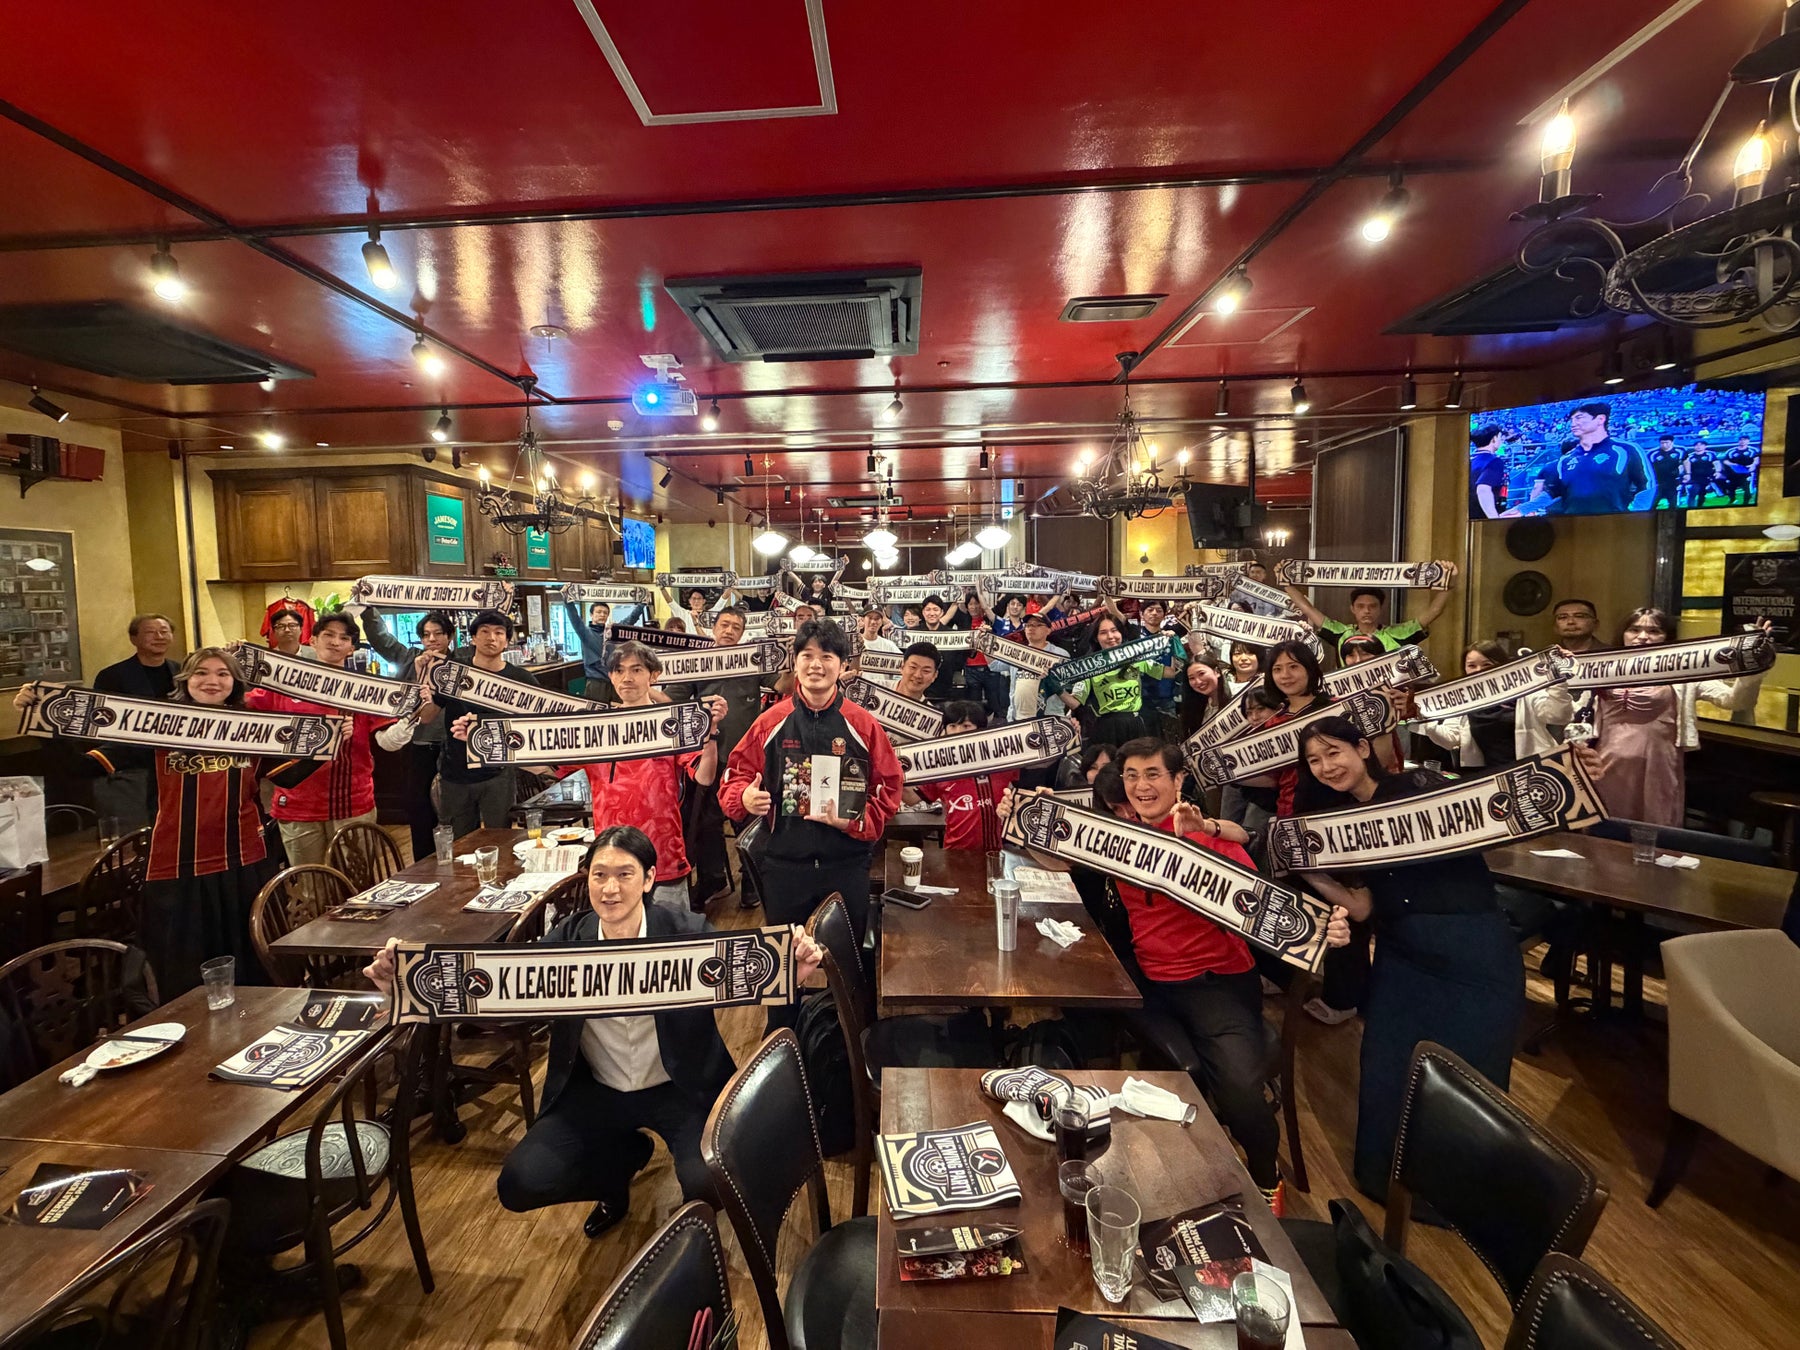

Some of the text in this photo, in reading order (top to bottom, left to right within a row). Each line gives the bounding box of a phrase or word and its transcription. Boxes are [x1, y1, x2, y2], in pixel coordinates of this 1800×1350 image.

[1129, 582, 1194, 594] K LEAGUE DAY IN JAPAN
[1317, 566, 1402, 580] K LEAGUE DAY IN JAPAN
[376, 583, 471, 602] K LEAGUE DAY IN JAPAN
[1208, 613, 1294, 641] K LEAGUE DAY IN JAPAN
[1767, 607, 1794, 616] PARTY
[641, 633, 664, 643] CITY
[665, 653, 749, 675] K LEAGUE DAY IN JAPAN
[1052, 652, 1106, 681] VAMOS
[1615, 657, 1628, 677] IN
[1630, 655, 1649, 675] DAY
[1652, 650, 1698, 673] LEAGUE
[1702, 648, 1711, 667] K
[273, 664, 282, 682] K
[282, 666, 319, 692] LEAGUE
[321, 678, 341, 697] DAY
[341, 683, 355, 700] IN
[353, 685, 387, 705] JAPAN
[474, 679, 484, 696] K
[484, 681, 517, 706] LEAGUE
[516, 691, 536, 712] DAY
[534, 696, 546, 713] IN
[1334, 679, 1352, 697] DAY
[1355, 675, 1365, 691] IN
[1366, 663, 1396, 688] JAPAN
[1423, 666, 1533, 712] K LEAGUE DAY IN JAPAN
[119, 709, 275, 744] K LEAGUE DAY IN JAPAN
[879, 699, 890, 716] K
[887, 703, 920, 728] LEAGUE
[917, 715, 936, 734] DAY
[1199, 709, 1242, 749] DAY IN JAPAN
[528, 719, 658, 750] K LEAGUE DAY IN JAPAN
[1235, 749, 1247, 767] K
[1243, 738, 1279, 765] LEAGUE
[1276, 732, 1295, 754] DAY
[914, 734, 1024, 771] K LEAGUE DAY IN JAPAN
[1513, 769, 1529, 795] PARTY
[1325, 826, 1338, 853] K
[1336, 815, 1388, 851] LEAGUE
[1391, 814, 1416, 846] DAY
[1418, 810, 1436, 841] IN
[1437, 797, 1484, 837] JAPAN
[1517, 794, 1549, 830] VIEWING
[1073, 823, 1232, 906] K LEAGUE DAY IN JAPAN
[1258, 911, 1278, 943] VIEWING
[1268, 889, 1288, 912] PARTY
[439, 954, 460, 1013] VIEWING PARTY
[498, 966, 510, 1000] K
[515, 963, 577, 1000] LEAGUE
[583, 961, 612, 996] DAY
[618, 962, 635, 995] IN
[639, 958, 694, 993] JAPAN
[732, 941, 750, 998] VIEWING PARTY
[934, 1137, 963, 1169] VIEWING
[949, 1170, 973, 1195] PARTY
[1178, 1220, 1202, 1264] RNATIONAL
